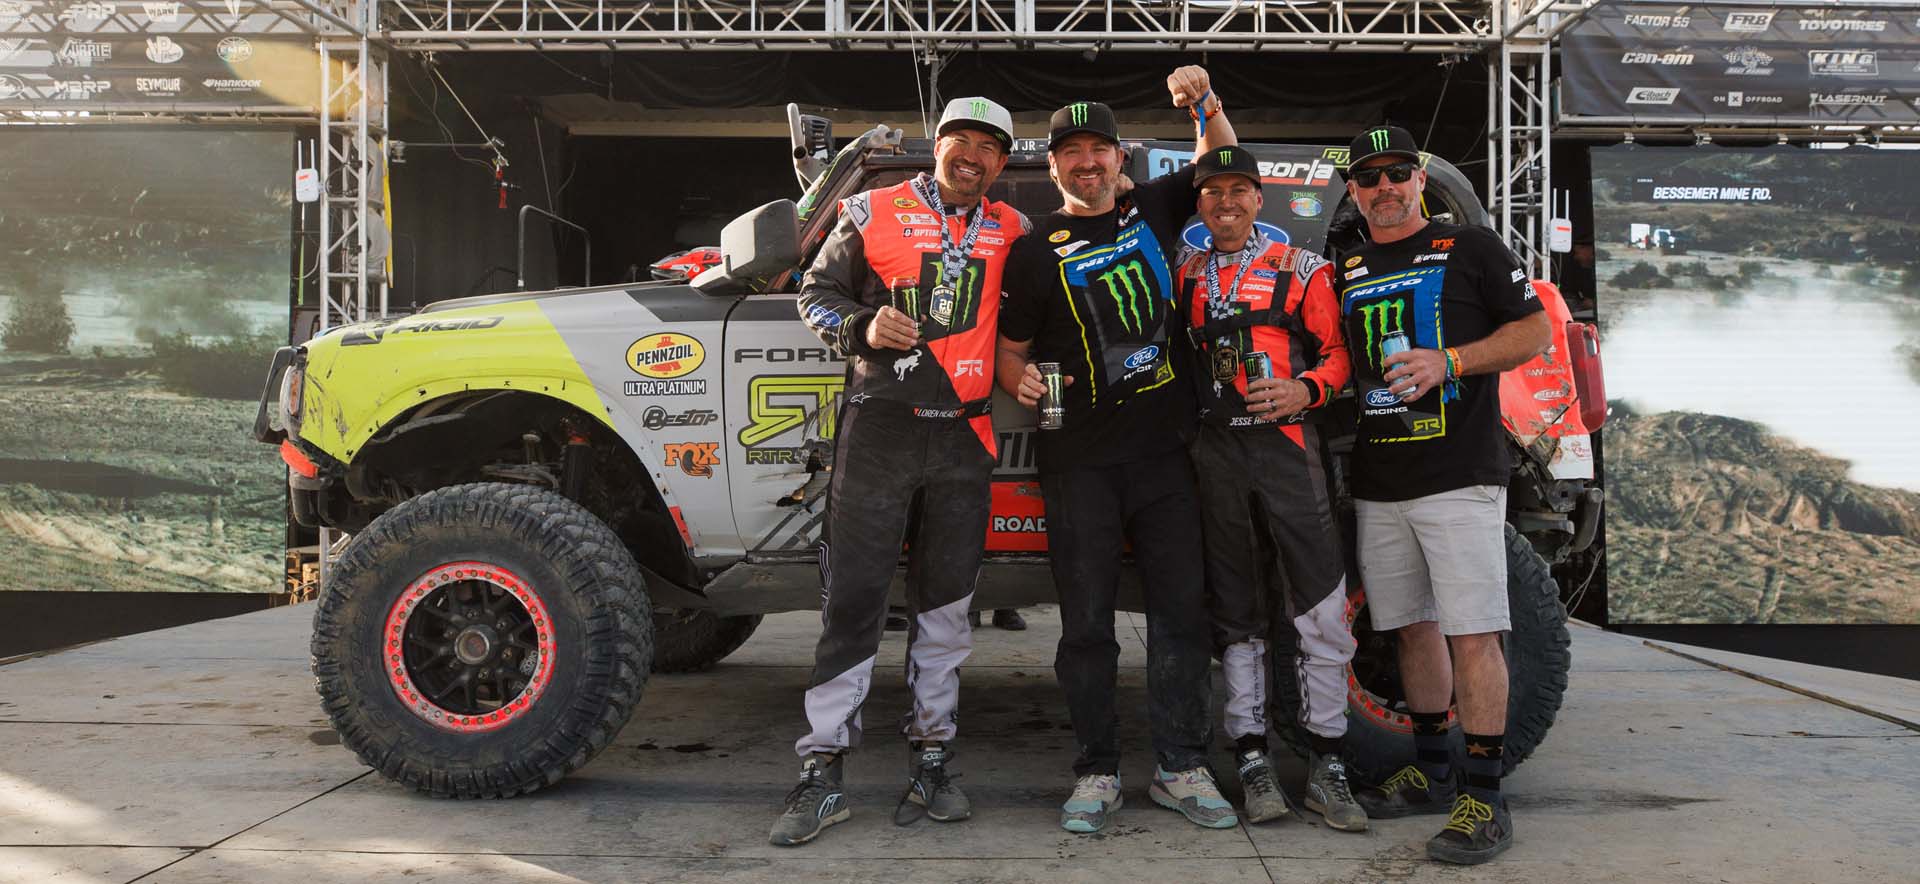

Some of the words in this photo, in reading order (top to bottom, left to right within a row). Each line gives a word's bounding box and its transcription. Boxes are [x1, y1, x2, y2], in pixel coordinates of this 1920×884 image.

[69, 4, 116, 20] PRP
[1624, 15, 1670, 28] FACTOR
[63, 39, 112, 59] CURRIE
[1813, 53, 1874, 65] KING
[54, 81, 111, 93] MBRP
[136, 78, 181, 91] SEYMOUR
[1819, 94, 1887, 104] LASERNUT
[1021, 140, 1036, 151] JR
[1653, 187, 1719, 200] BESSEMER
[1720, 187, 1750, 200] MINE
[1751, 188, 1772, 200] RD.
[1350, 278, 1423, 298] NITTO
[636, 344, 694, 367] PENNZOIL
[624, 382, 654, 396] ULTRA
[656, 380, 706, 395] PLATINUM
[1370, 390, 1396, 404] Ford
[918, 409, 938, 417] LOREN
[1229, 417, 1253, 426] JESSE
[664, 442, 720, 472] FOX
[747, 450, 794, 463] RTR
